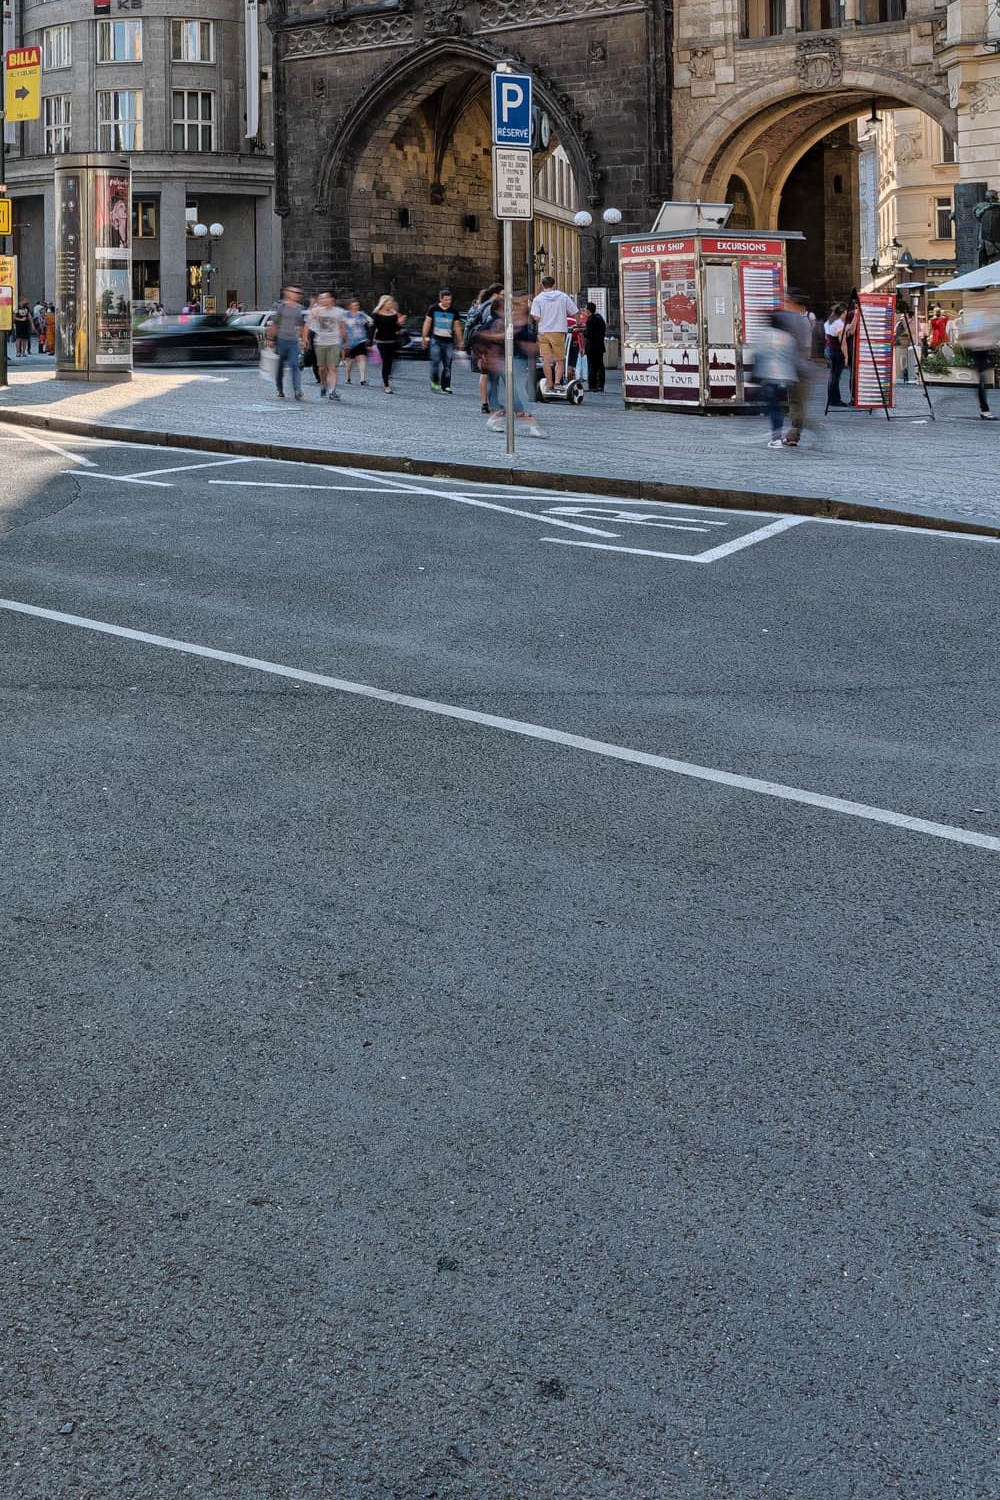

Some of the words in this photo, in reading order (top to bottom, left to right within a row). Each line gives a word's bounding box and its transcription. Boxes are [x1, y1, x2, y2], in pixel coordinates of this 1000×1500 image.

[117, 0, 143, 11] KB
[8, 50, 38, 67] BILLA
[501, 82, 524, 123] P
[497, 126, 529, 138] RÉSERVÉ
[631, 245, 655, 254] CRUISE
[657, 244, 666, 252] BY
[667, 243, 685, 251] SHIP
[716, 242, 767, 252] EXCURSIONS
[626, 374, 659, 383] MARTIN
[671, 375, 693, 384] TOUR
[709, 374, 736, 383] MARTIN
